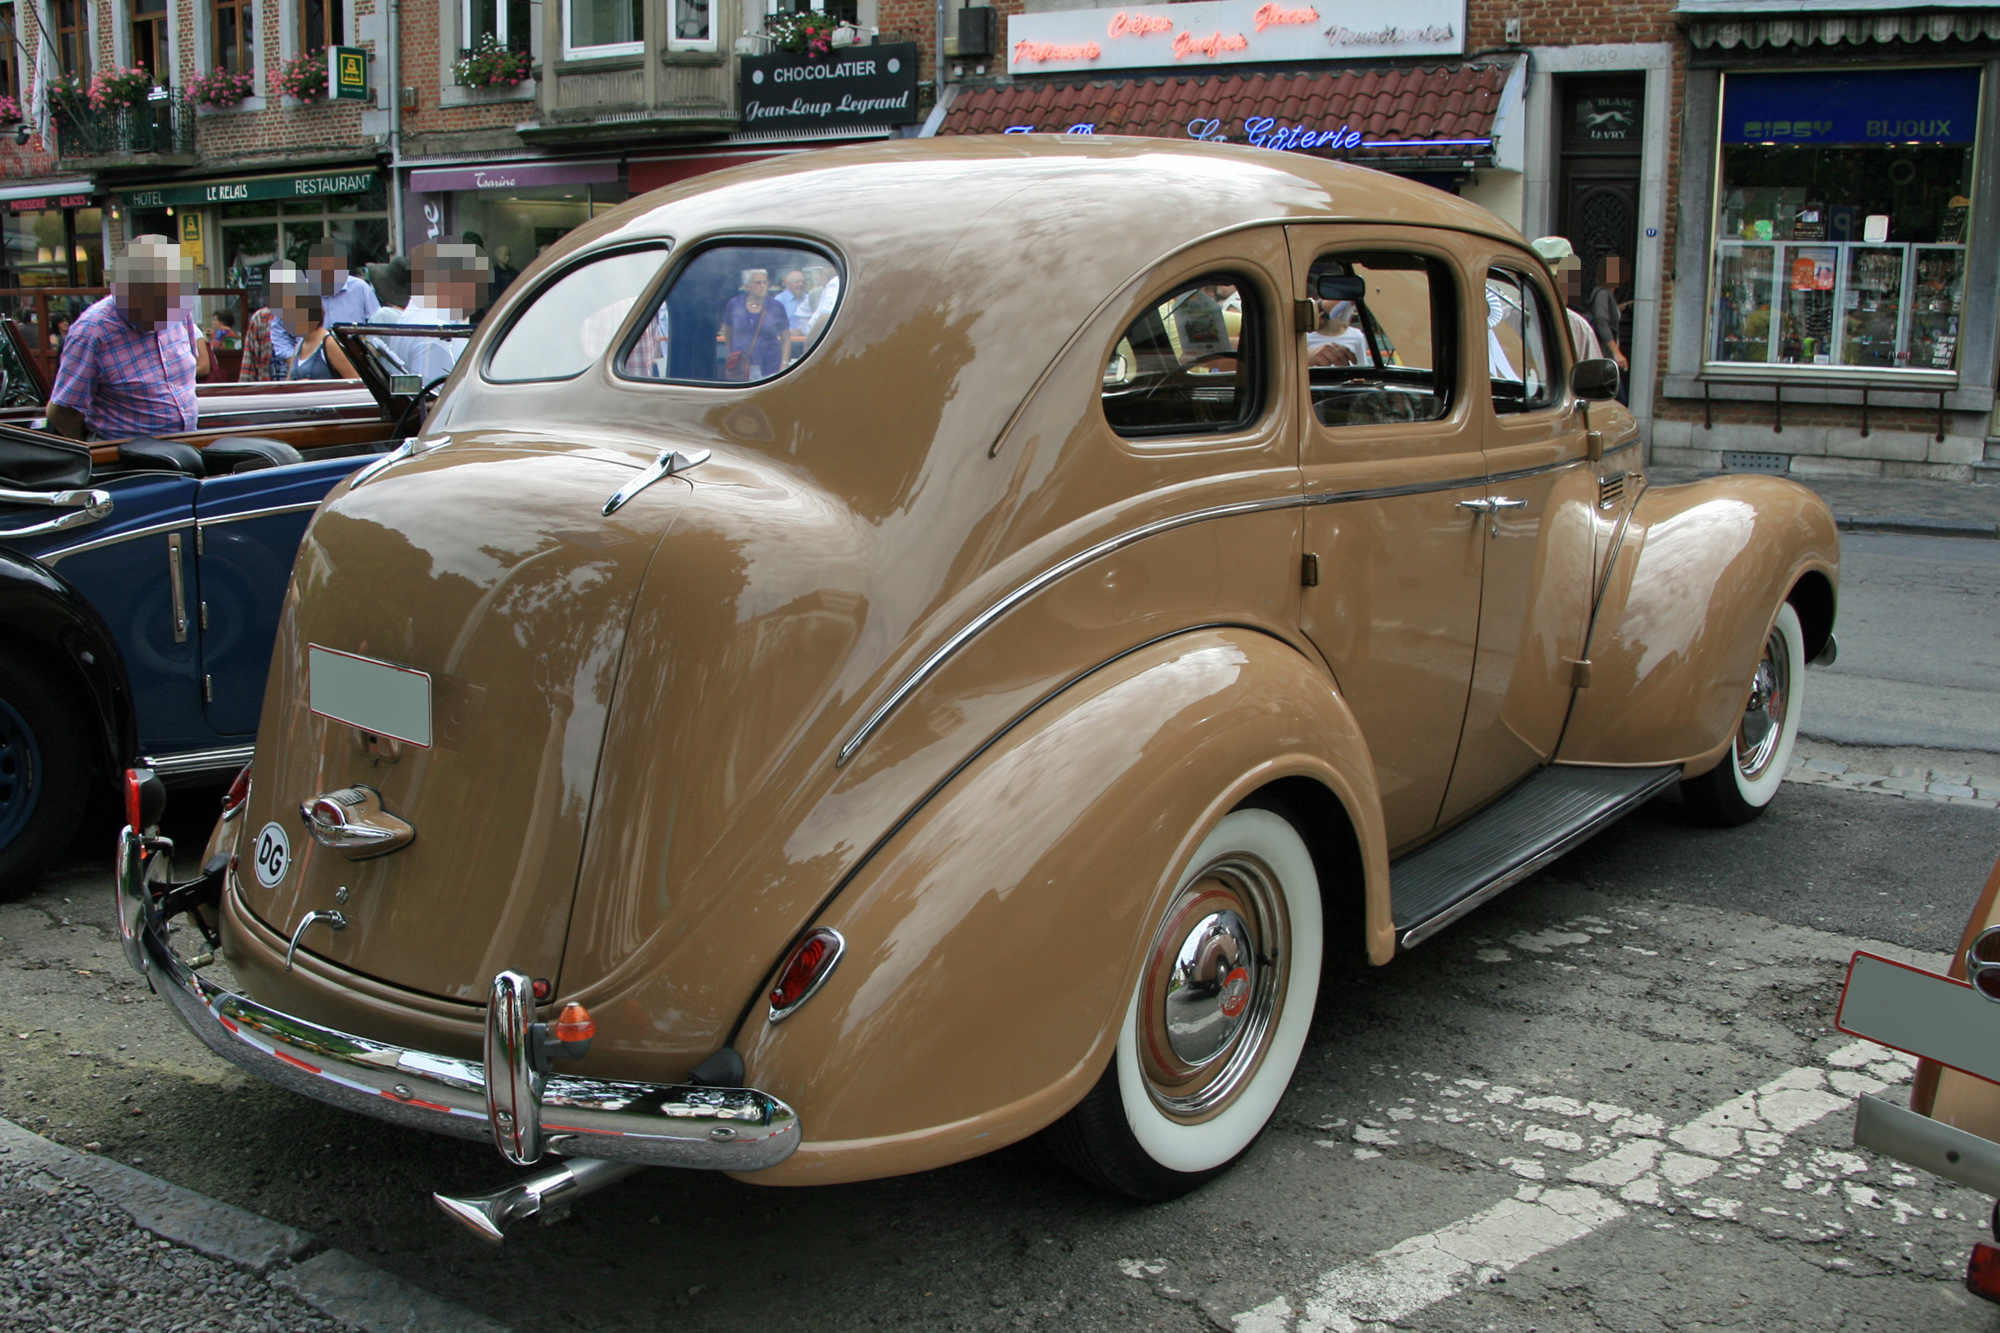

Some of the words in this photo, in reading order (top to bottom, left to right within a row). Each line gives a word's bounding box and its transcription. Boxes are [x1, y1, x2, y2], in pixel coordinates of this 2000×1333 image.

[1107, 11, 1172, 38] Crêpes
[1253, 3, 1319, 32] Glaces
[1172, 31, 1248, 59] Gaufres
[1579, 50, 1617, 65] 1669
[774, 60, 876, 83] CHOCOLATIER
[746, 98, 833, 121] Jean-Loup
[835, 90, 909, 115] Legrand
[1598, 97, 1636, 108] BLANC
[1244, 116, 1362, 151] Gâterie
[1866, 120, 1951, 137] BIJOUX
[474, 171, 516, 188] Tsarine
[60, 195, 87, 207] GLACES
[133, 191, 164, 206] HOTEL
[206, 187, 217, 200] LE
[219, 184, 248, 199] RELAIS
[258, 833, 284, 876] DG
